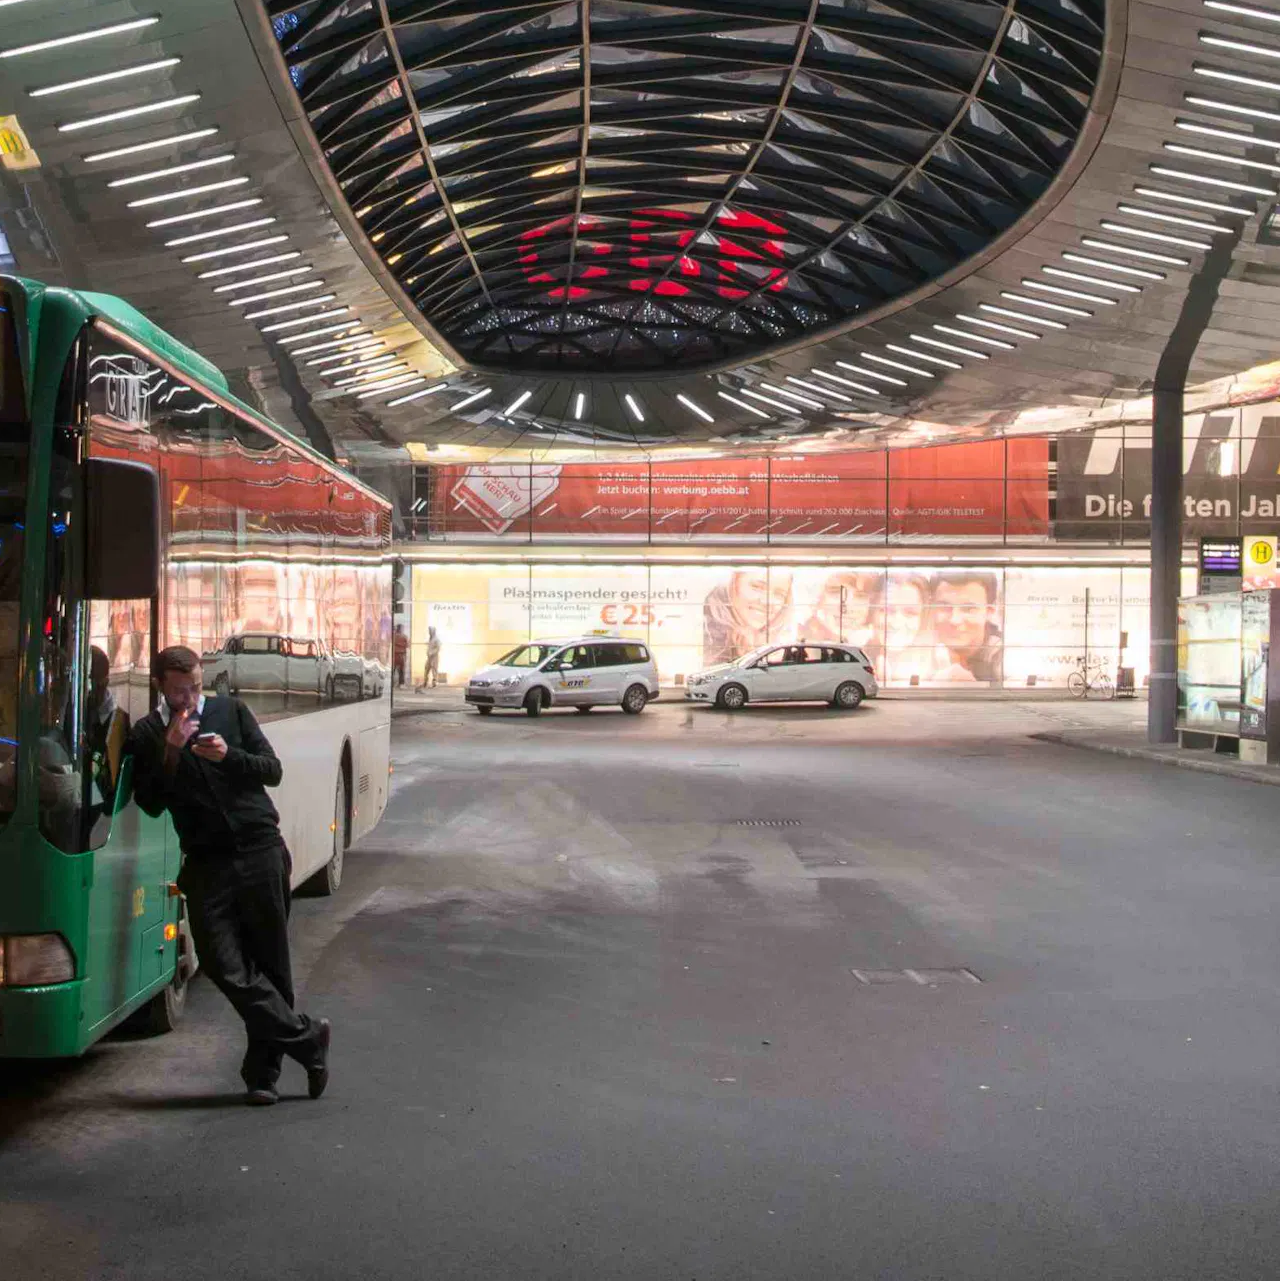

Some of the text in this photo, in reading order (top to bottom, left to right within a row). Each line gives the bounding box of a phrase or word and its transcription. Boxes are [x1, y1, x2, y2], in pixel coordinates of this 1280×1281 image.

[596, 484, 619, 495] Jetzt
[662, 484, 750, 497] werbung.oebb.at
[1085, 494, 1133, 518] Die
[1141, 494, 1232, 518] ften
[502, 586, 689, 605] Plasmaspender gesucht!
